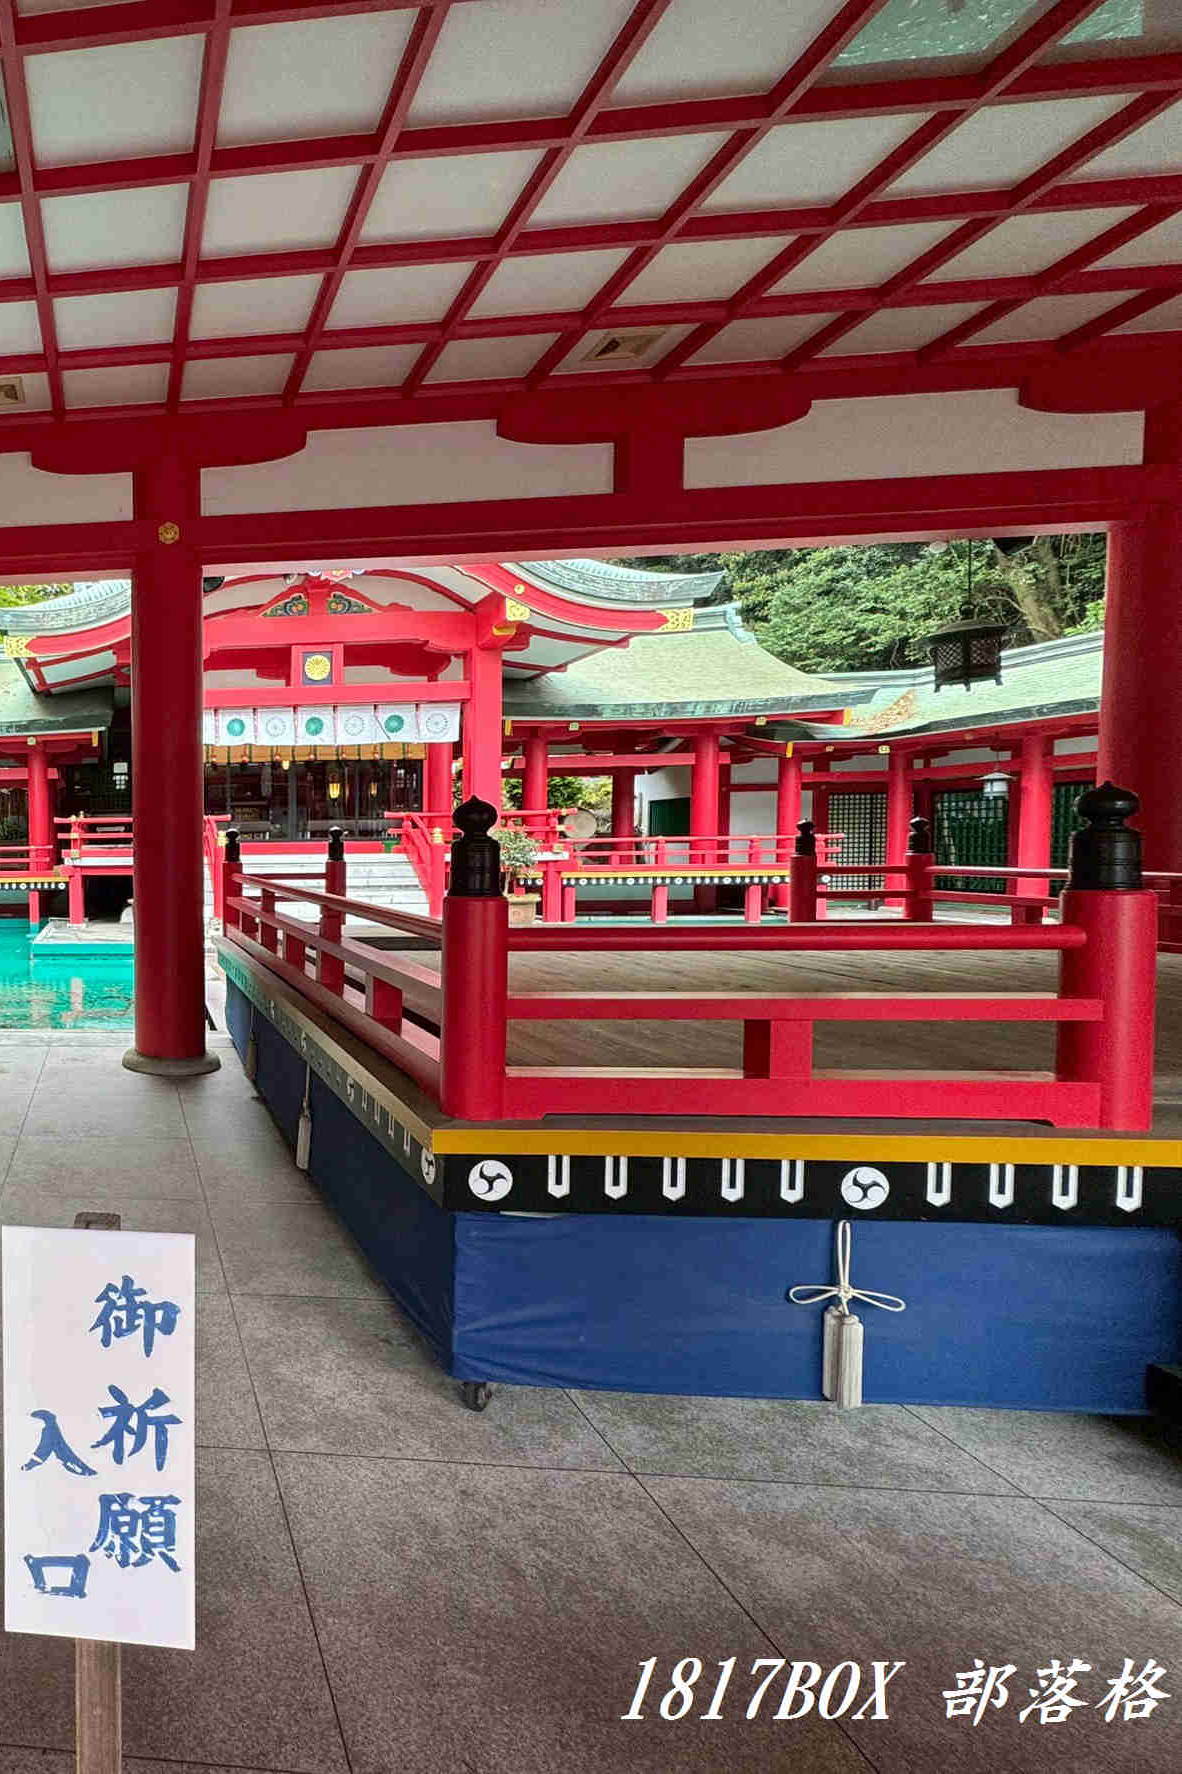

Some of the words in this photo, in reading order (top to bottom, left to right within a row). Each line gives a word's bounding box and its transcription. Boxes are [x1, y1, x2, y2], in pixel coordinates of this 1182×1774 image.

[21, 1409, 97, 1598] 入口
[89, 1275, 183, 1573] 御祈願
